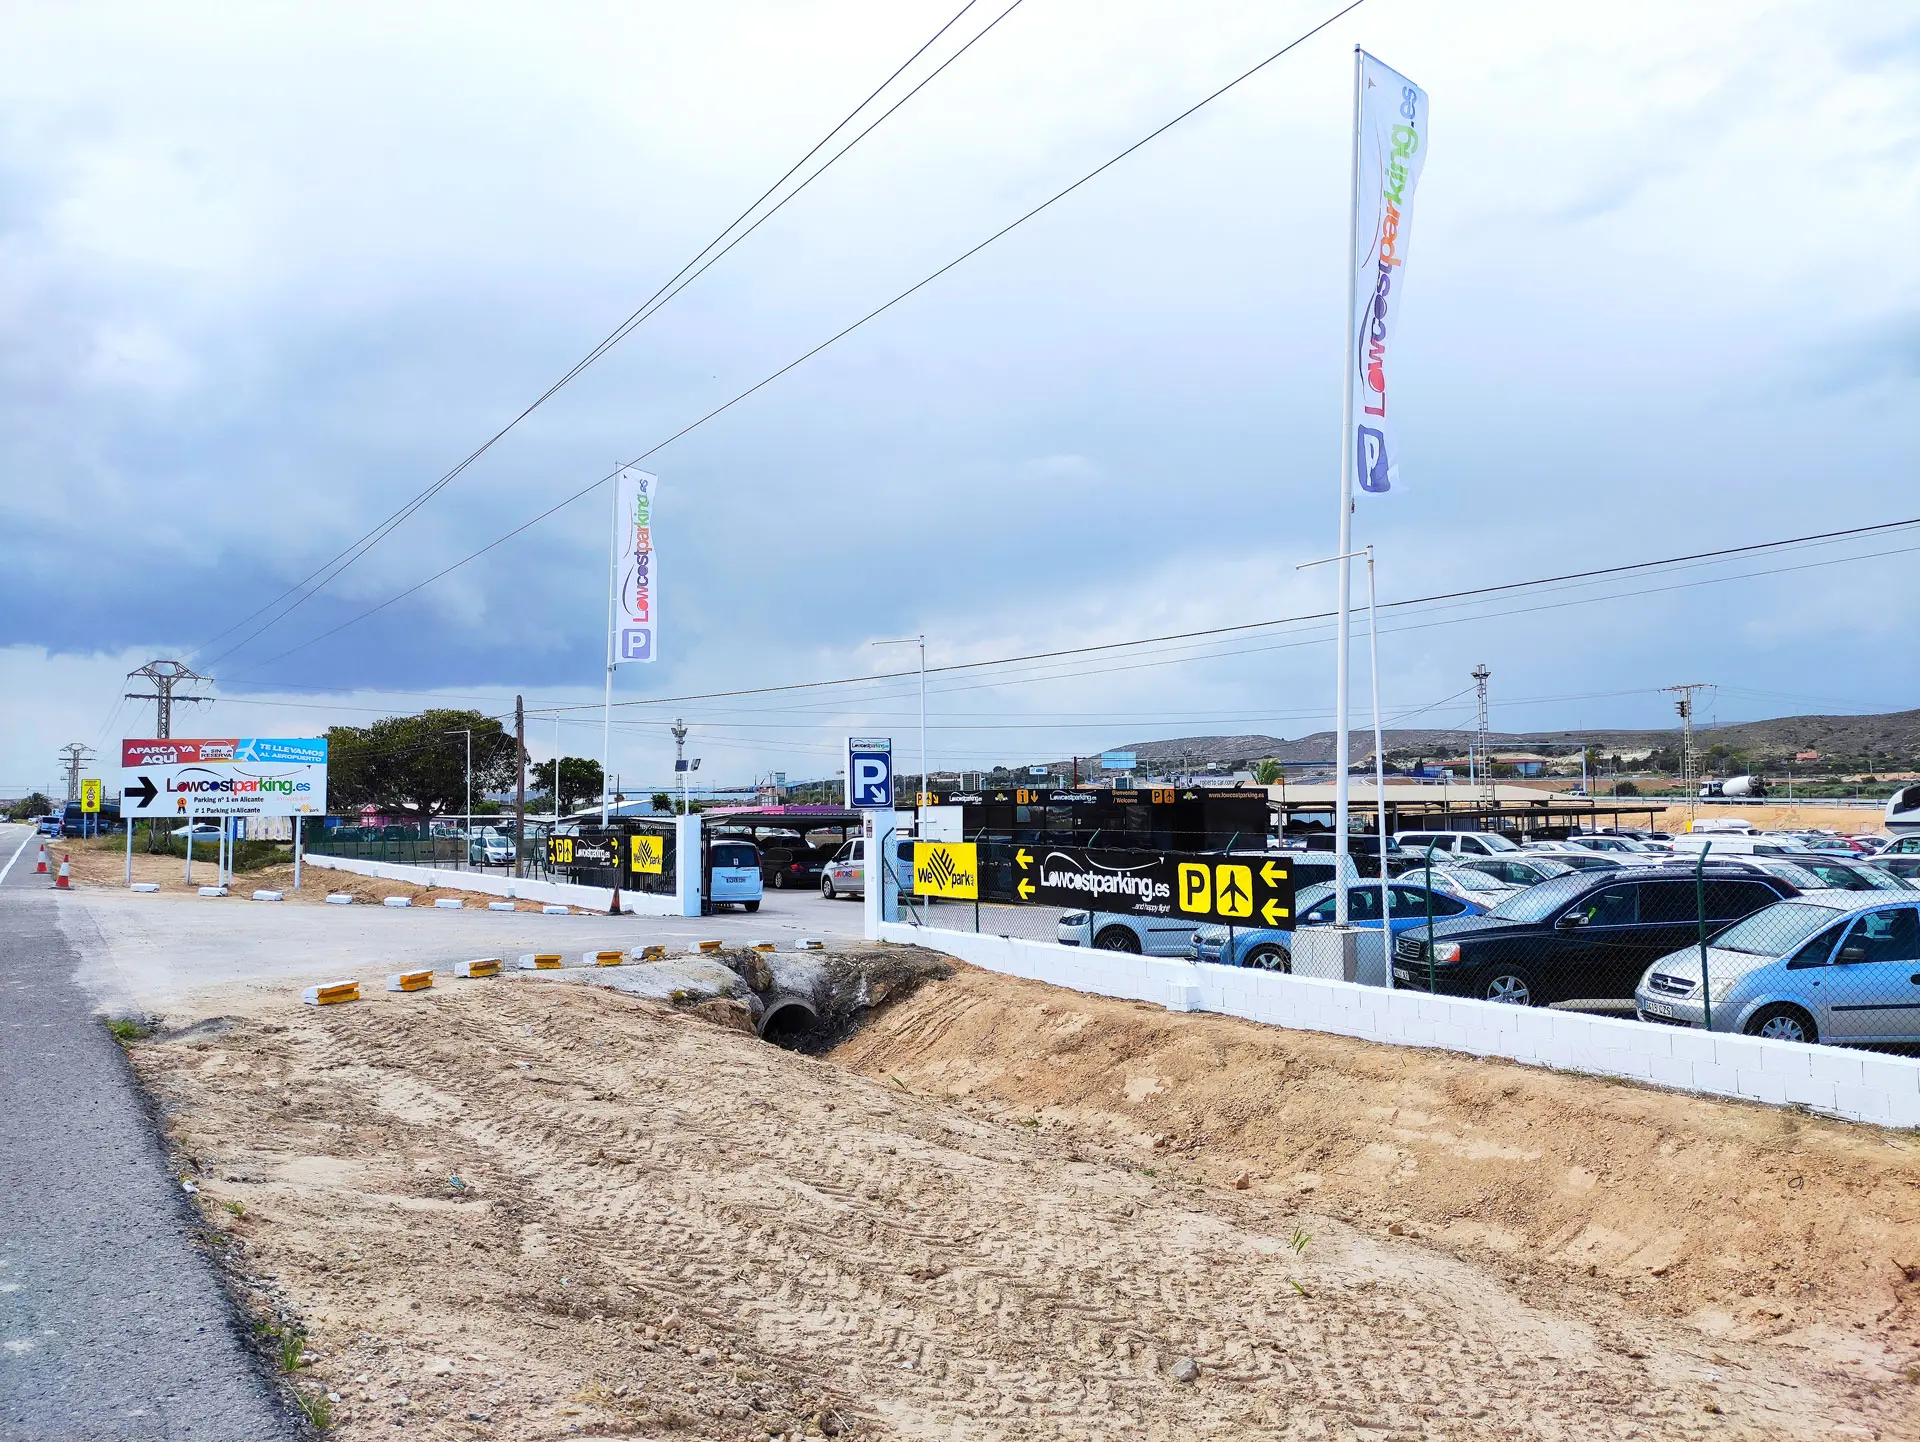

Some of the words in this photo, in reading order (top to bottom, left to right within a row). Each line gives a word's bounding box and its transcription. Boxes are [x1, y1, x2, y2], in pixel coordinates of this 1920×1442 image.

[1364, 86, 1419, 418] Lowcostparking.es
[633, 478, 653, 623] Lowcostparking.es
[627, 632, 647, 657] P
[127, 746, 179, 755] APARCA
[179, 745, 196, 753] YA
[141, 753, 178, 765] AQUÍ
[260, 743, 272, 751] TE
[272, 745, 325, 758] LLEVAMOS
[271, 753, 322, 763] AEROPUERTO
[166, 777, 311, 797] Lowcostparking.es
[855, 759, 888, 799] P
[194, 796, 216, 804] Parking
[206, 807, 230, 815] Parking
[917, 867, 933, 884] We
[951, 869, 971, 889] park
[1040, 864, 1171, 902] Lowcostparking.es
[1186, 869, 1206, 906] P
